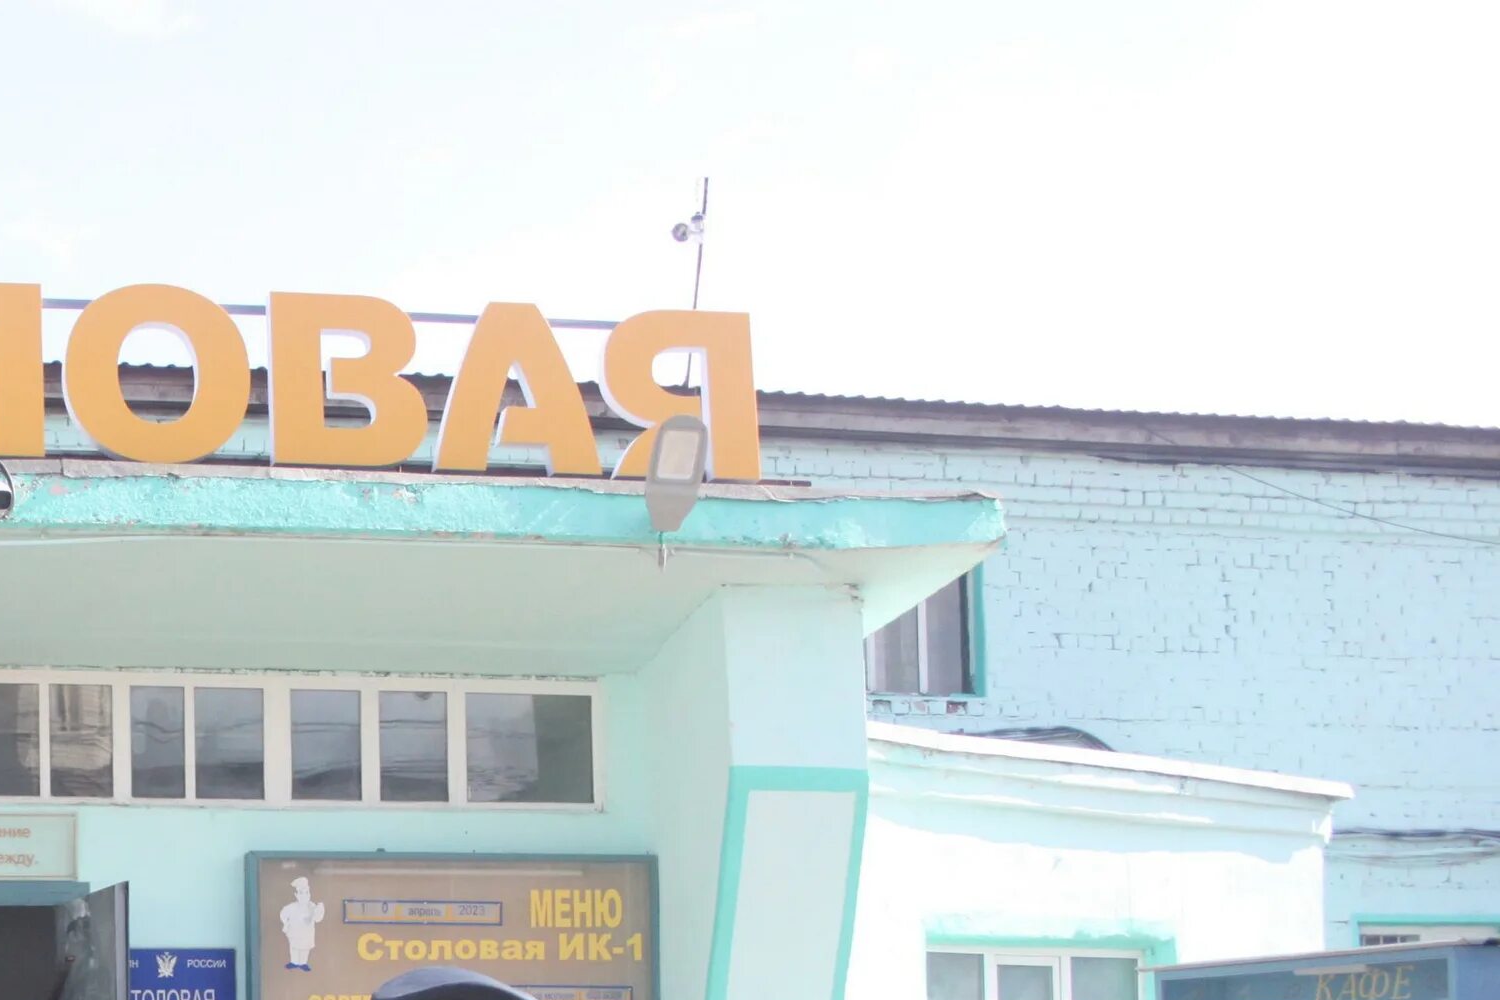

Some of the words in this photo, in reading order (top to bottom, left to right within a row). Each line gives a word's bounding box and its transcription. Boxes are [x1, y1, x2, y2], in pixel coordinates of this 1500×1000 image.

[458, 905, 487, 916] 2023
[529, 889, 623, 928] МЕНЮ
[357, 933, 546, 961] Столовая
[558, 933, 643, 961] ИК-1
[187, 959, 227, 968] РОССИИ
